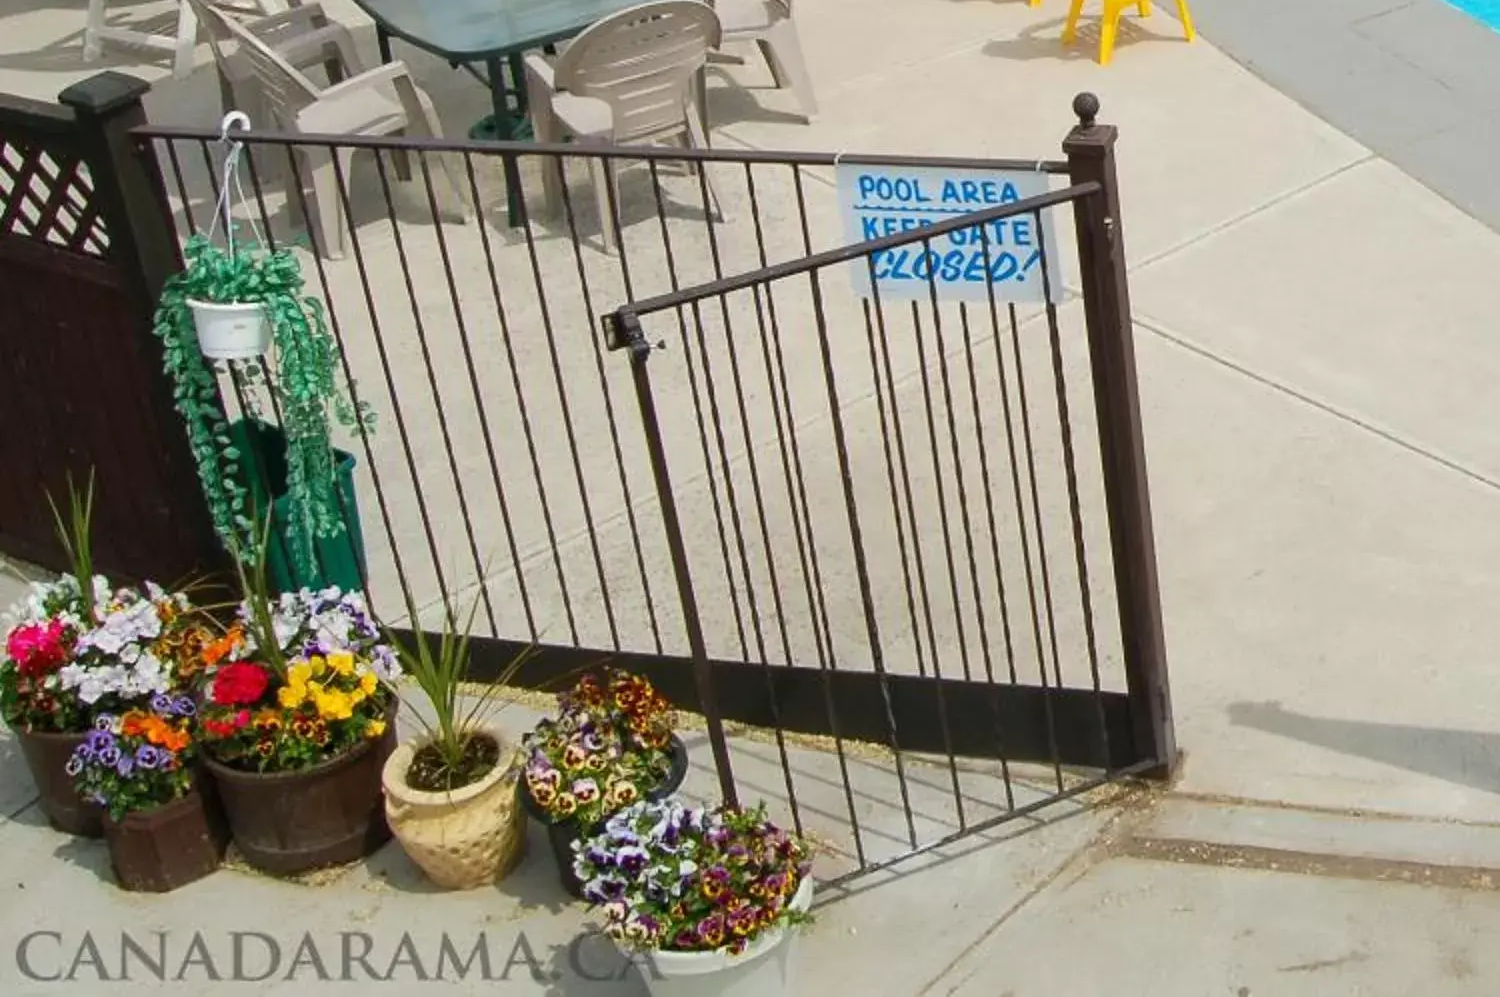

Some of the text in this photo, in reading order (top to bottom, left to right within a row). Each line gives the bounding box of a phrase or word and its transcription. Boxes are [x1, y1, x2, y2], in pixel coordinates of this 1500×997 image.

[859, 174, 1018, 203] POOL AREA
[870, 249, 1040, 282] CLOSED!
